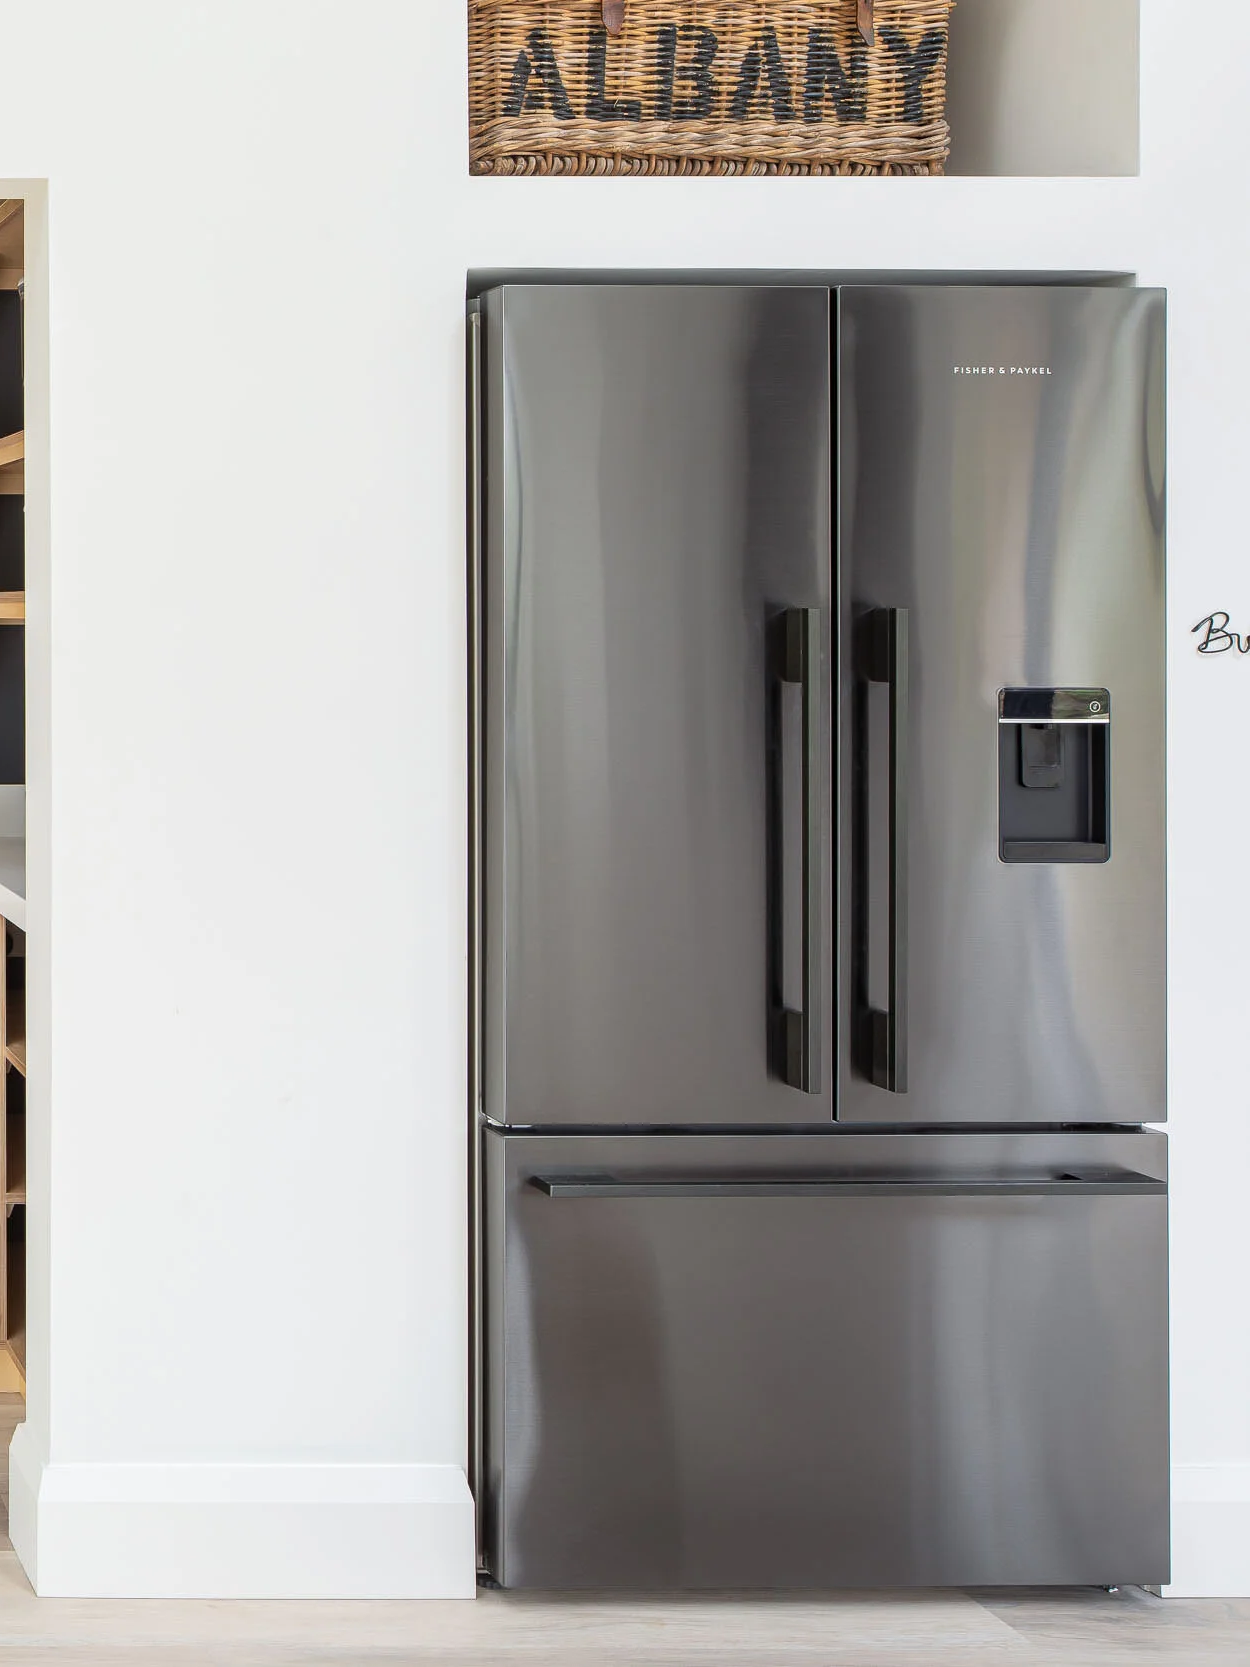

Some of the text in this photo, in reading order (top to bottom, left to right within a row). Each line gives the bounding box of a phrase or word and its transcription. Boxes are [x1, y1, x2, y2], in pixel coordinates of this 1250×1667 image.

[503, 24, 947, 123] ALBANY
[953, 366, 1052, 375] FISHER & PAYKEL
